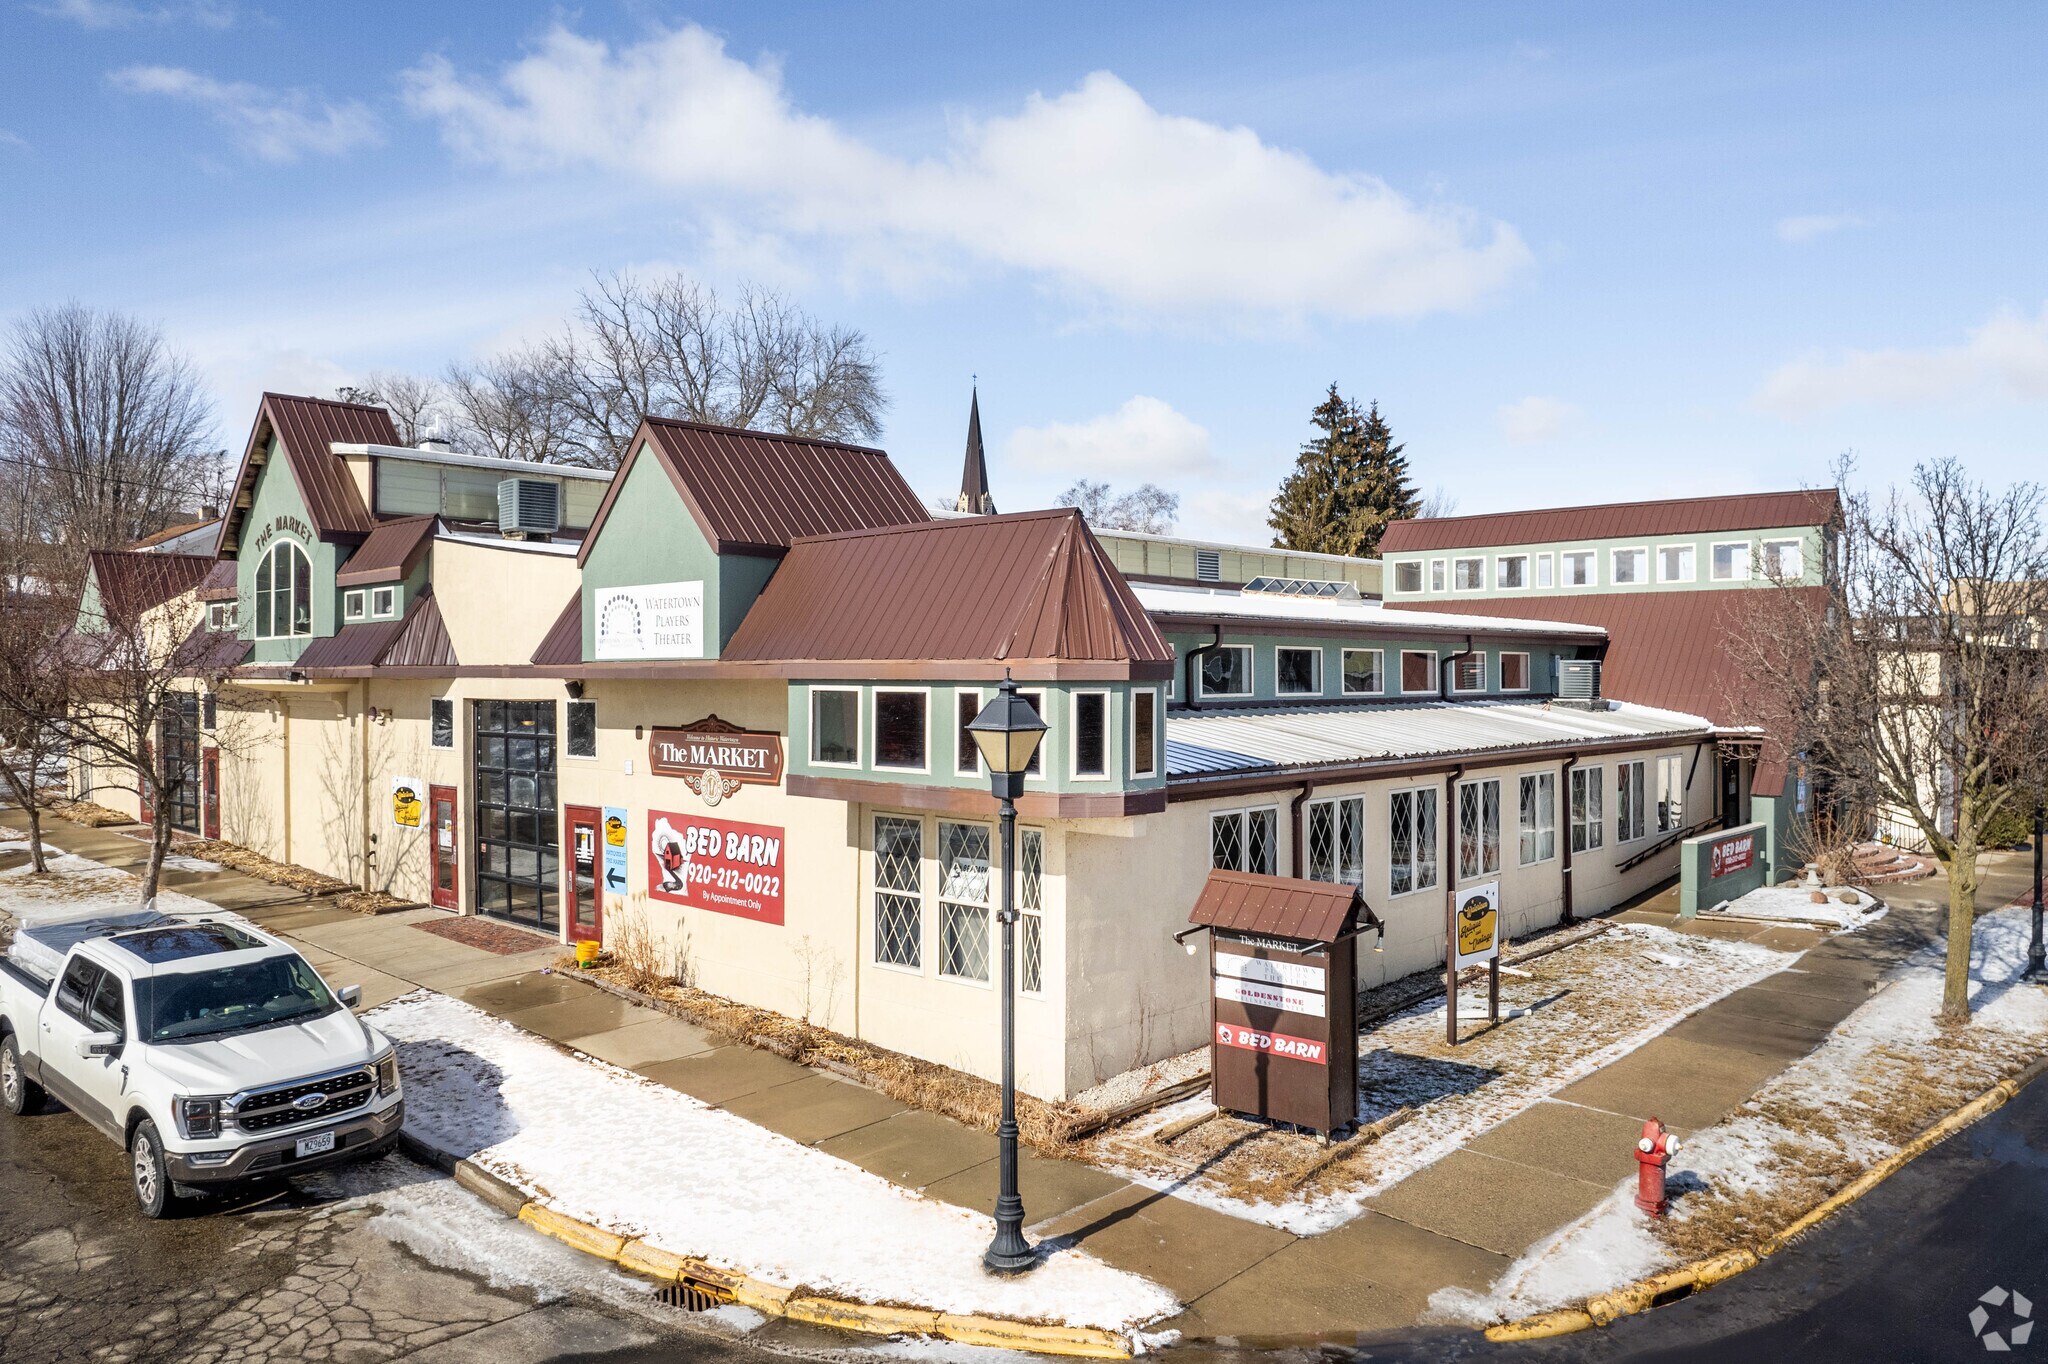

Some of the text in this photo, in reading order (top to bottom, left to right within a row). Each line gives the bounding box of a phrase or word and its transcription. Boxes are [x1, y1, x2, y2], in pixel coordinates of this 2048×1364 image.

[255, 515, 312, 552] THE MARKET
[645, 596, 700, 610] WATERTOWN
[656, 615, 690, 627] PLAYERS
[654, 632, 692, 645] THEATER
[660, 743, 769, 768] The MARKET
[686, 826, 780, 868] BED BARN
[1722, 843, 1734, 857] BED
[689, 862, 780, 898] 920-212-0022
[703, 890, 762, 912] By Appointment Only
[1239, 935, 1299, 952] The MARKET
[1235, 988, 1304, 1006] GOLDENSTONE
[1238, 1031, 1321, 1059] BED BARN
